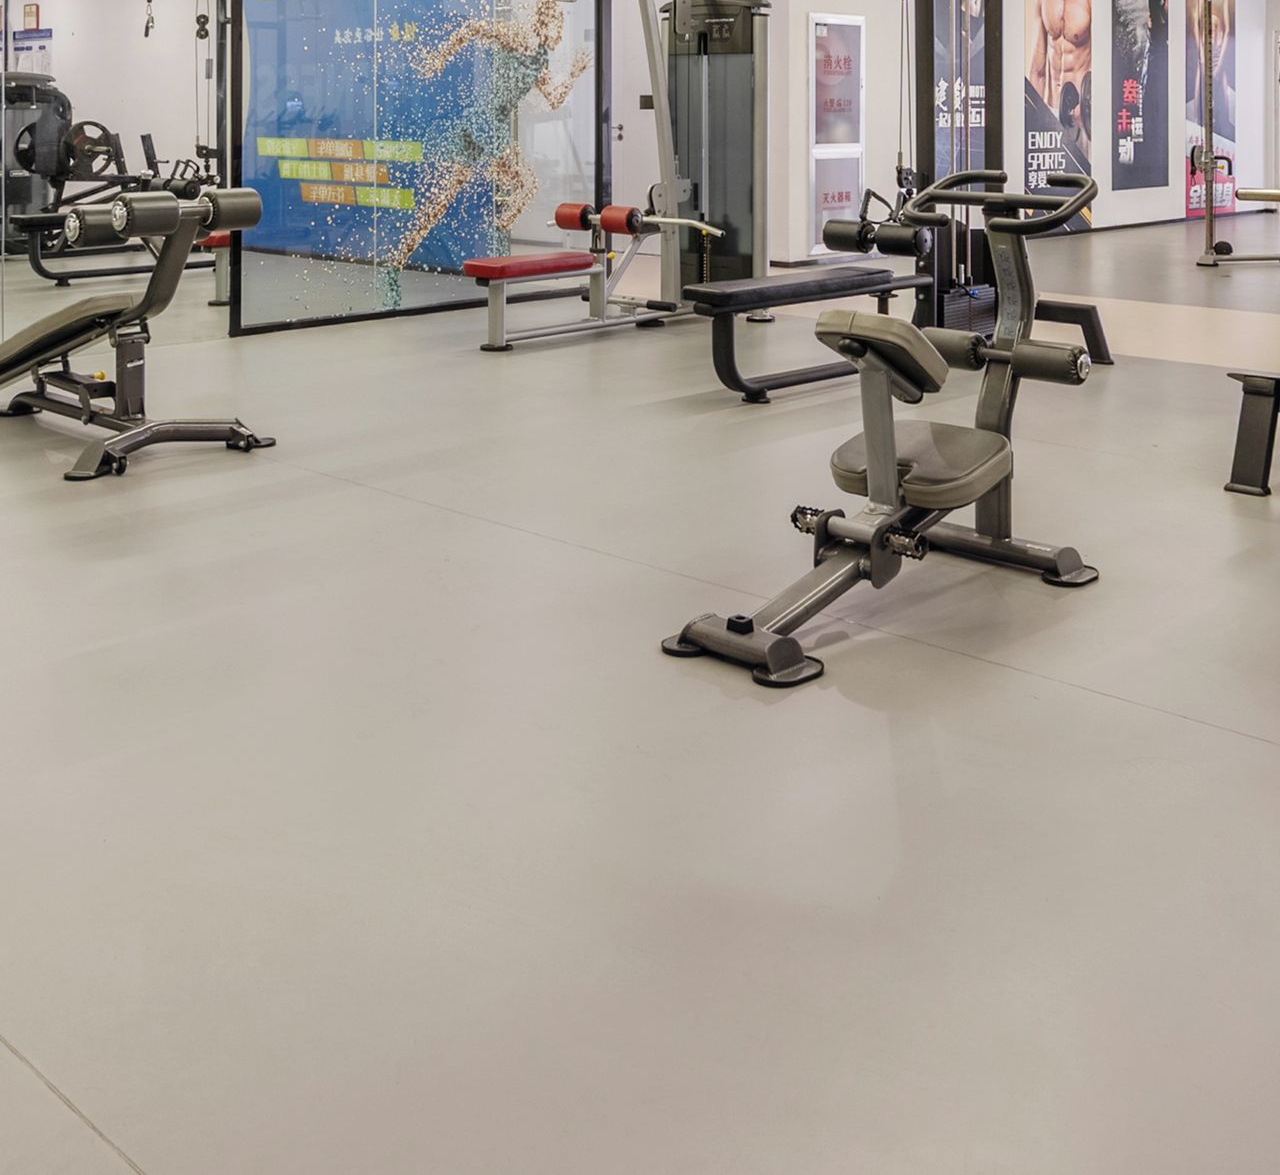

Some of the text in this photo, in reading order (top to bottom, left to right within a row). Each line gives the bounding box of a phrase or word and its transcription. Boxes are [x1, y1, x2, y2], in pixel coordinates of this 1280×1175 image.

[824, 55, 852, 70] 消火栓
[1028, 131, 1062, 149] ENJOY
[1028, 151, 1066, 170] SPORTS
[1028, 170, 1064, 189] 享受
[822, 191, 851, 204] 灭火器箱
